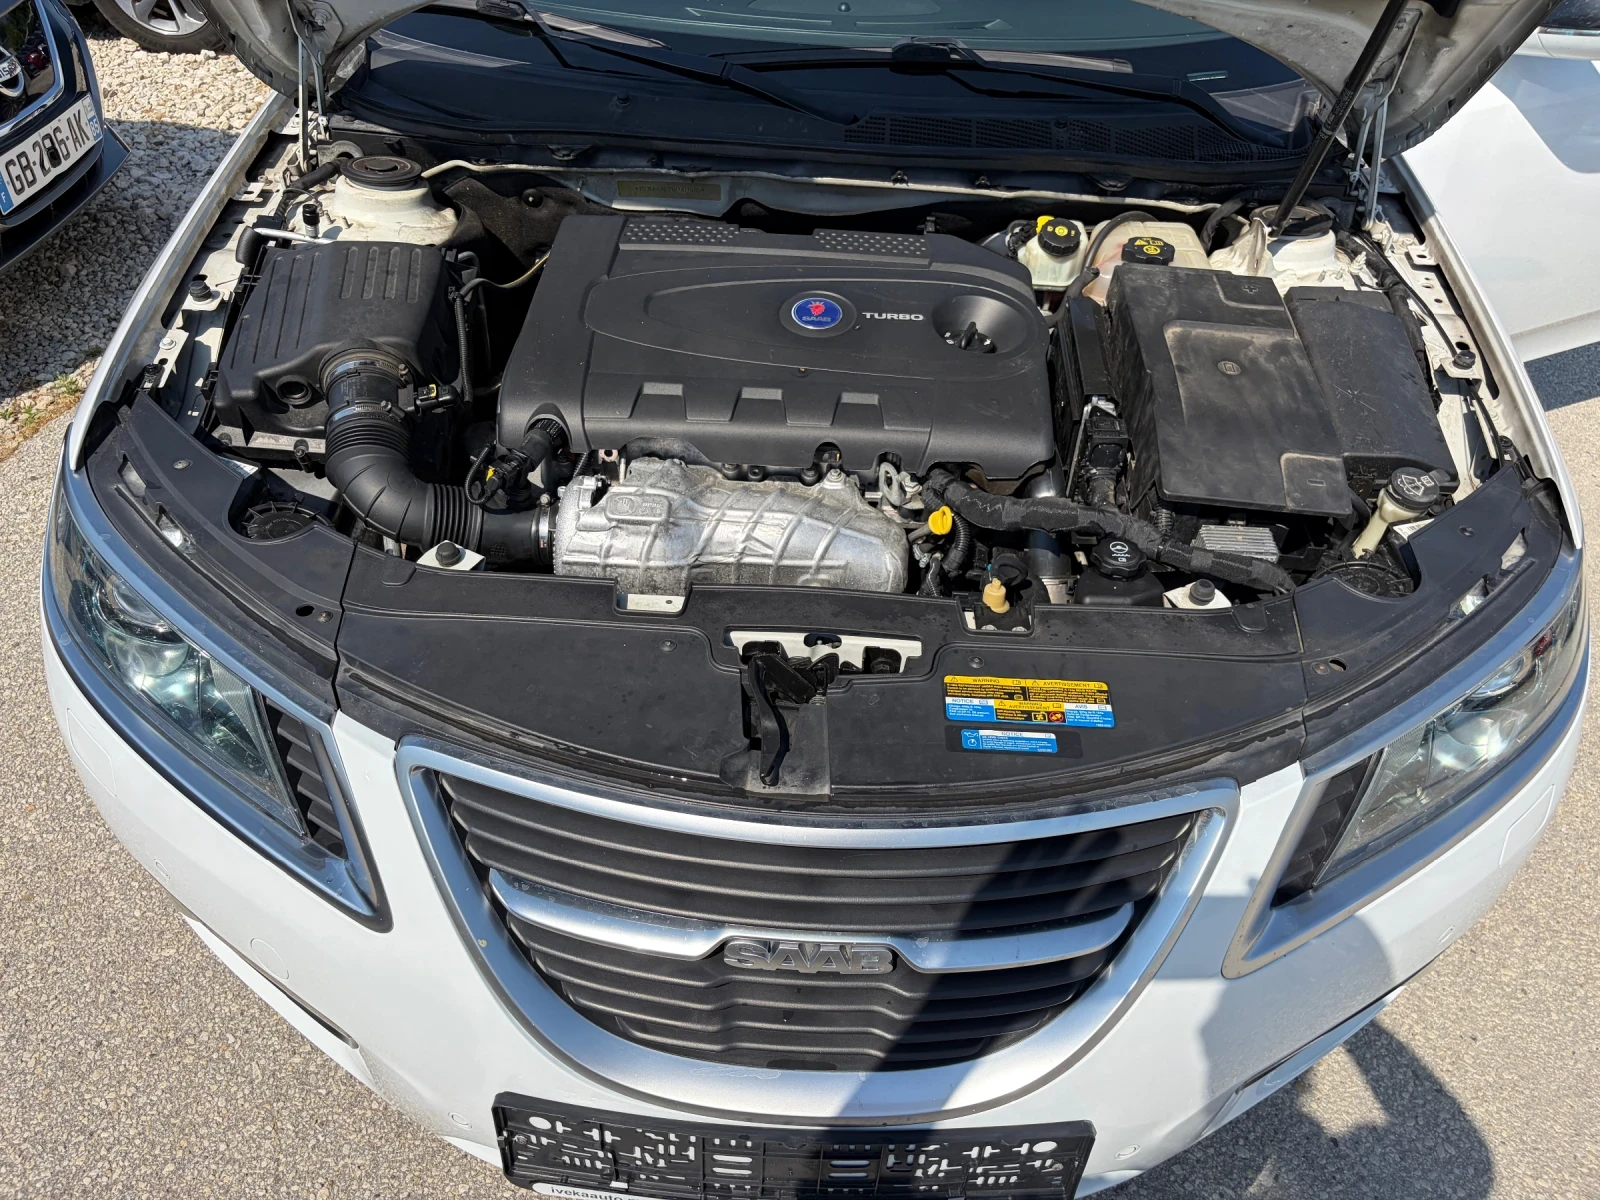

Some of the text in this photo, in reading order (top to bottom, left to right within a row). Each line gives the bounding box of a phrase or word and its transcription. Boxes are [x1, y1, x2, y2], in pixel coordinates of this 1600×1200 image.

[89, 118, 100, 135] 85
[1, 191, 6, 203] F
[862, 312, 924, 321] TURBO
[723, 940, 893, 975] SAAB
